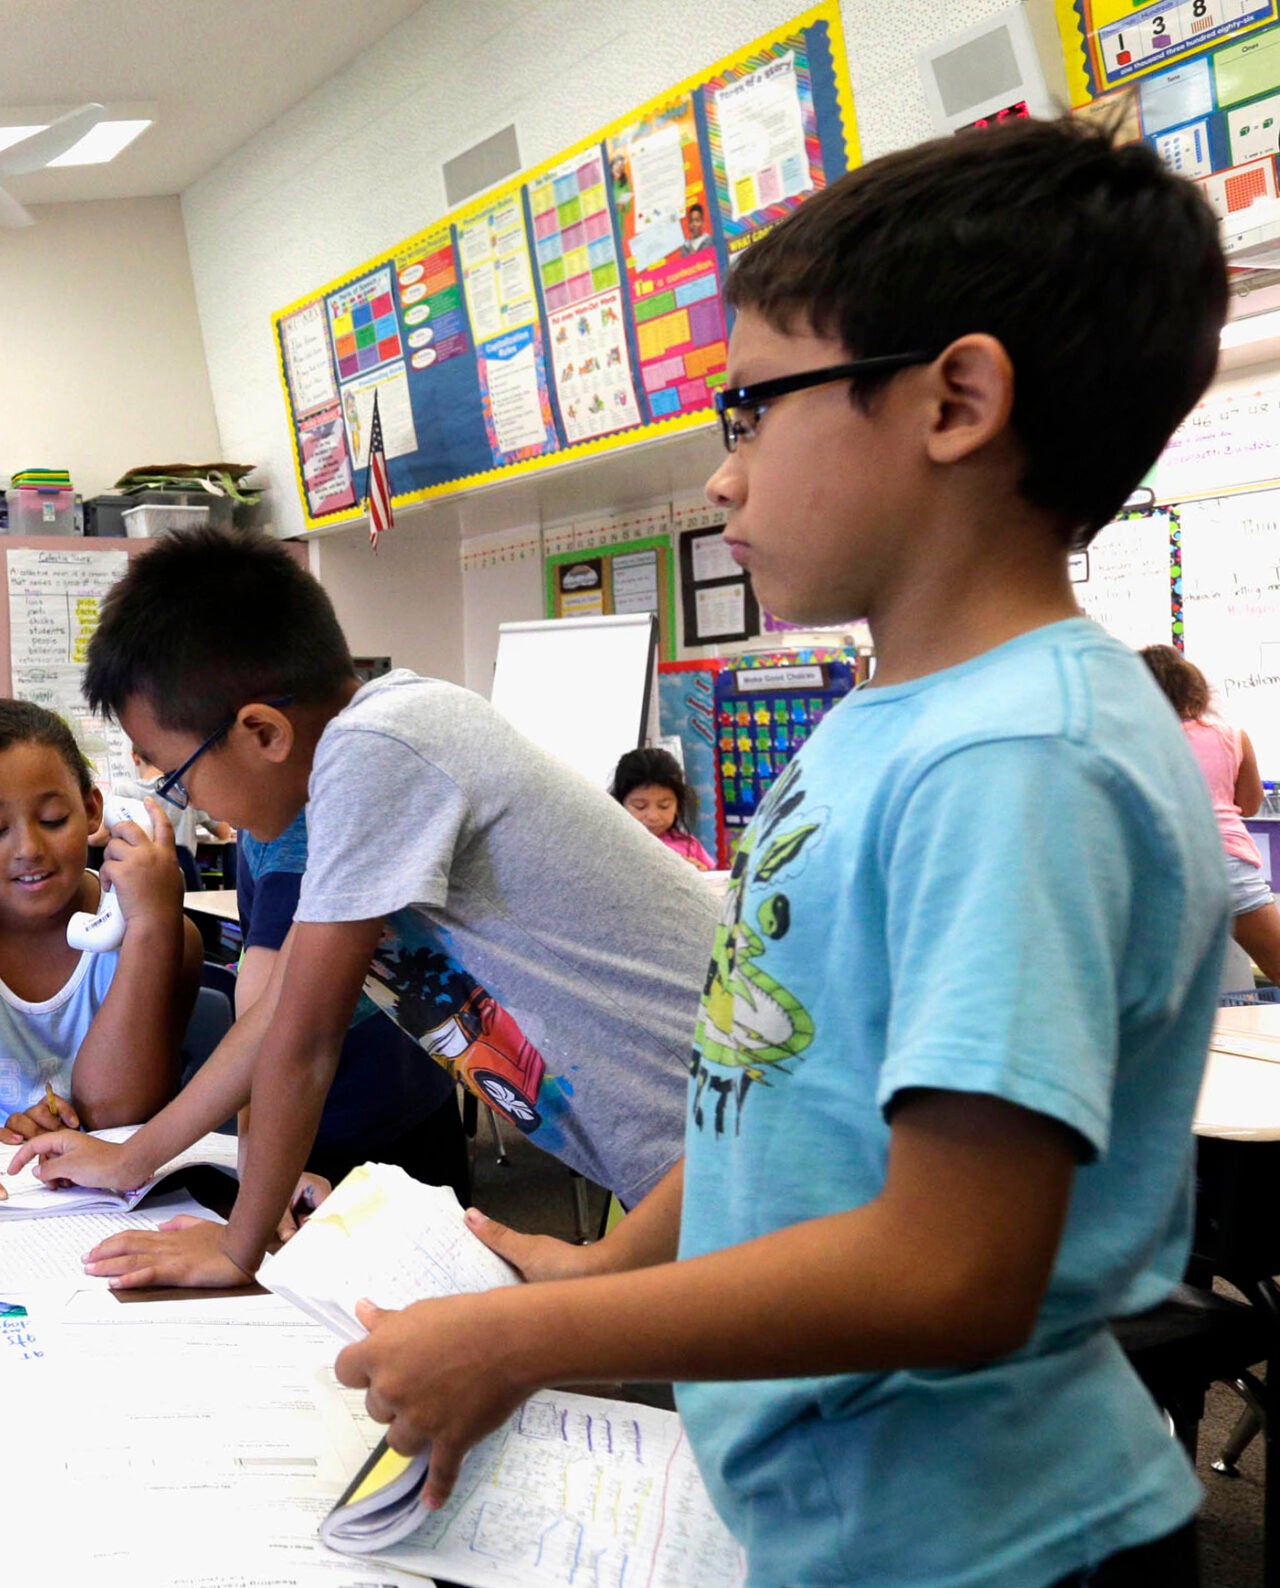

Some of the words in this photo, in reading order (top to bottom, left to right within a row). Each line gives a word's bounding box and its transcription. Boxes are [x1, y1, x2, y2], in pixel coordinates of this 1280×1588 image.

[1152, 16, 1167, 35] 3
[1192, 0, 1208, 17] 8
[1120, 64, 1133, 75] one
[1134, 51, 1166, 69] thousand
[1166, 42, 1186, 54] three
[1186, 31, 1217, 48] hundred
[1218, 14, 1255, 34] eighty-six
[1241, 42, 1260, 53] Ones
[634, 272, 654, 297] I'm
[29, 627, 65, 635] students
[743, 675, 763, 685] Make
[765, 673, 785, 683] Good
[786, 671, 816, 682] Choices
